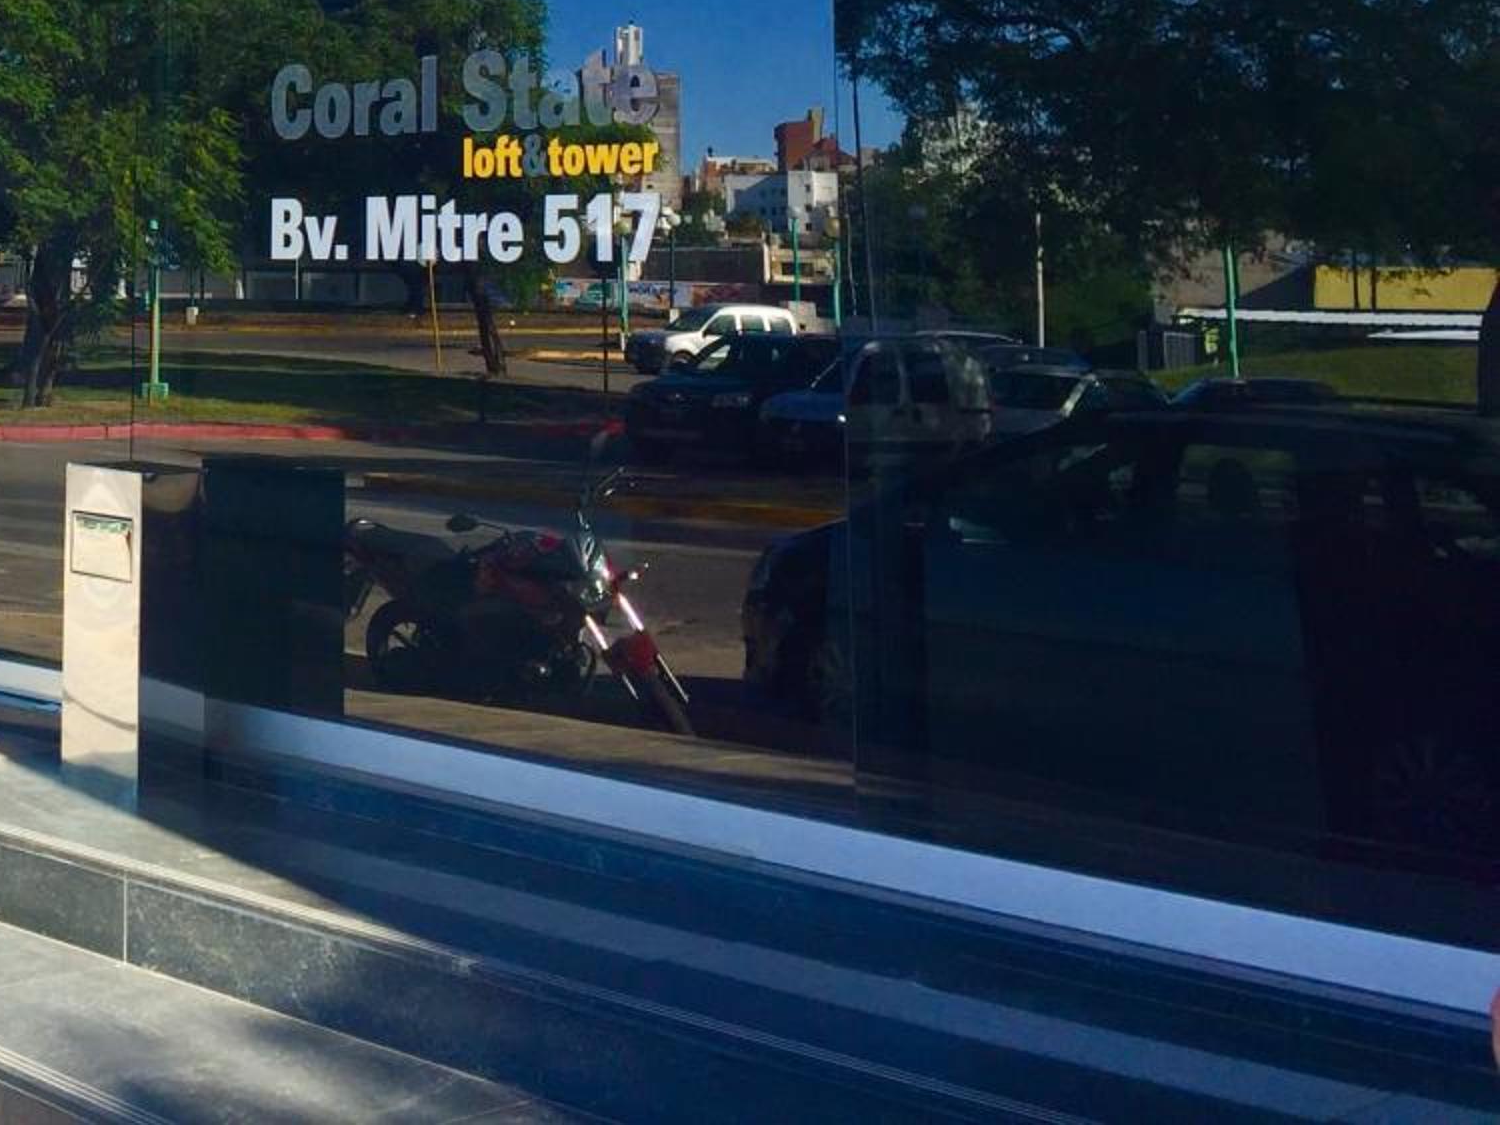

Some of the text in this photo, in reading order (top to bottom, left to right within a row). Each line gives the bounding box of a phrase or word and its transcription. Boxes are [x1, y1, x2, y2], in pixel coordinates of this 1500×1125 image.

[271, 49, 659, 140] Coral State
[271, 193, 661, 264] Bv. Mitre 517
